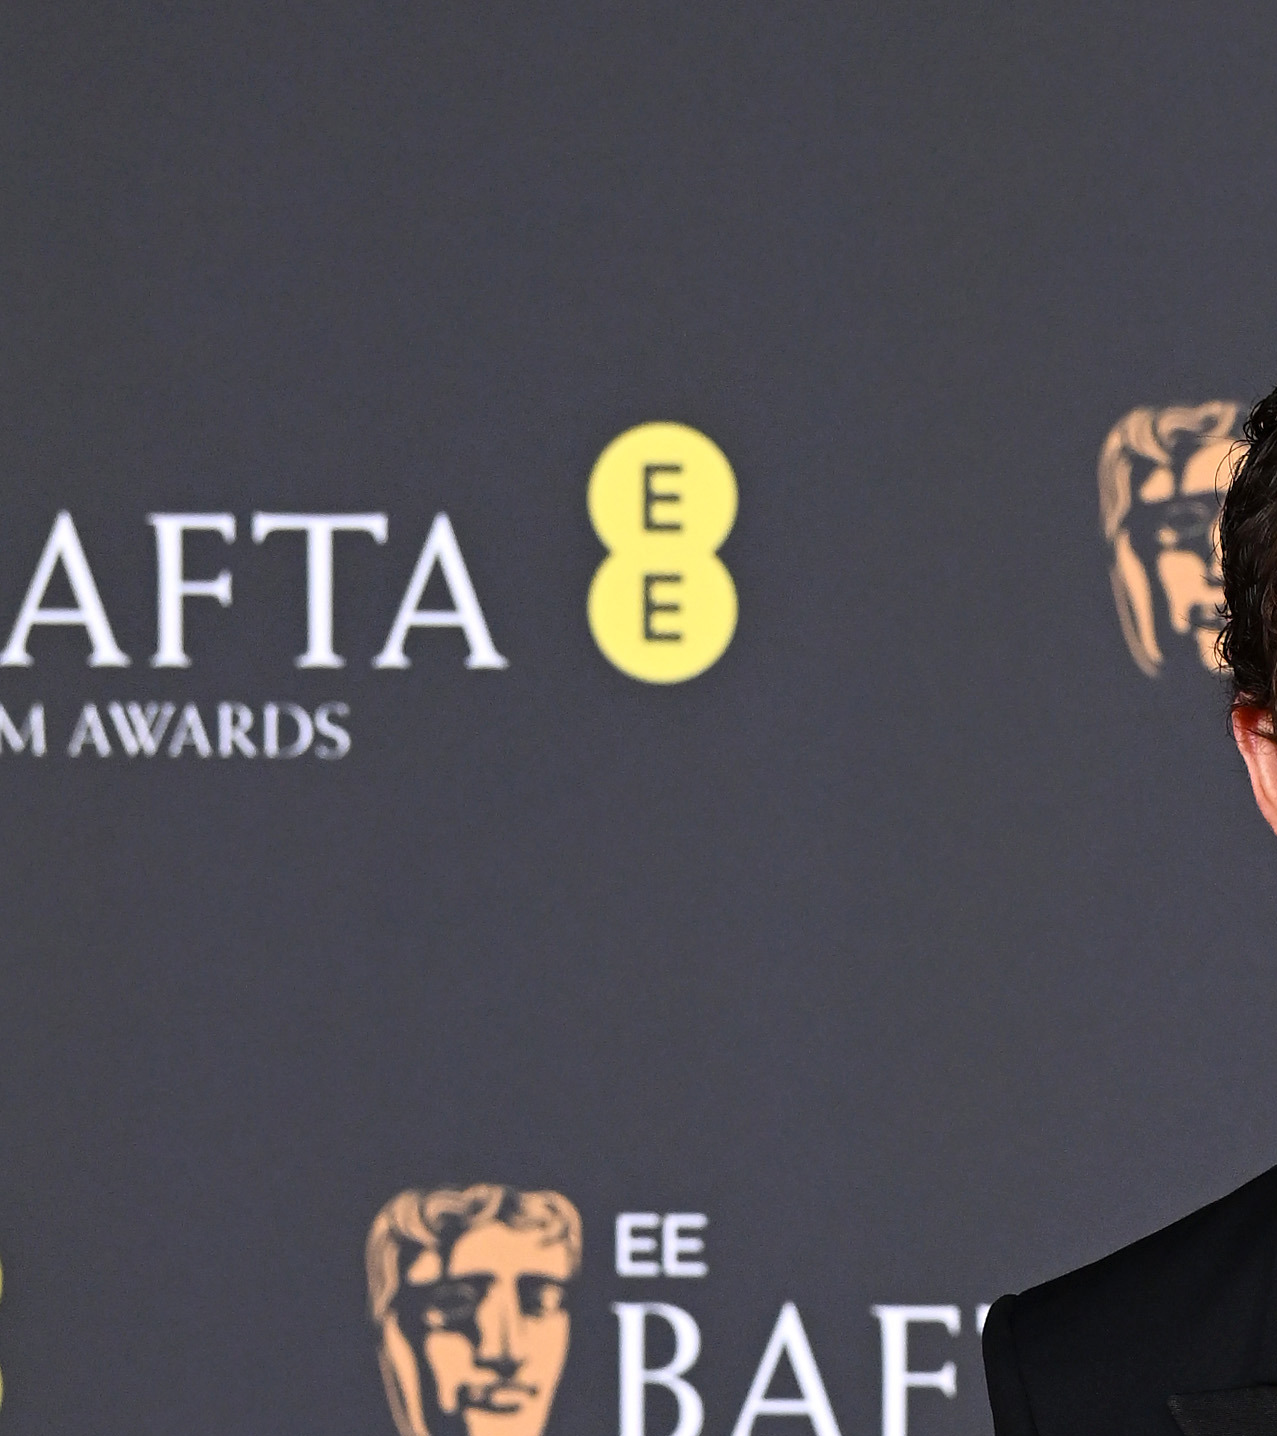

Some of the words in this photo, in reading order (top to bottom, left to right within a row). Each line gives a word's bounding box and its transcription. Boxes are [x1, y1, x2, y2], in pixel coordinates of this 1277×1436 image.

[0, 511, 508, 669] AFTA
[69, 702, 351, 758] AWARDS
[615, 1212, 708, 1277] EE
